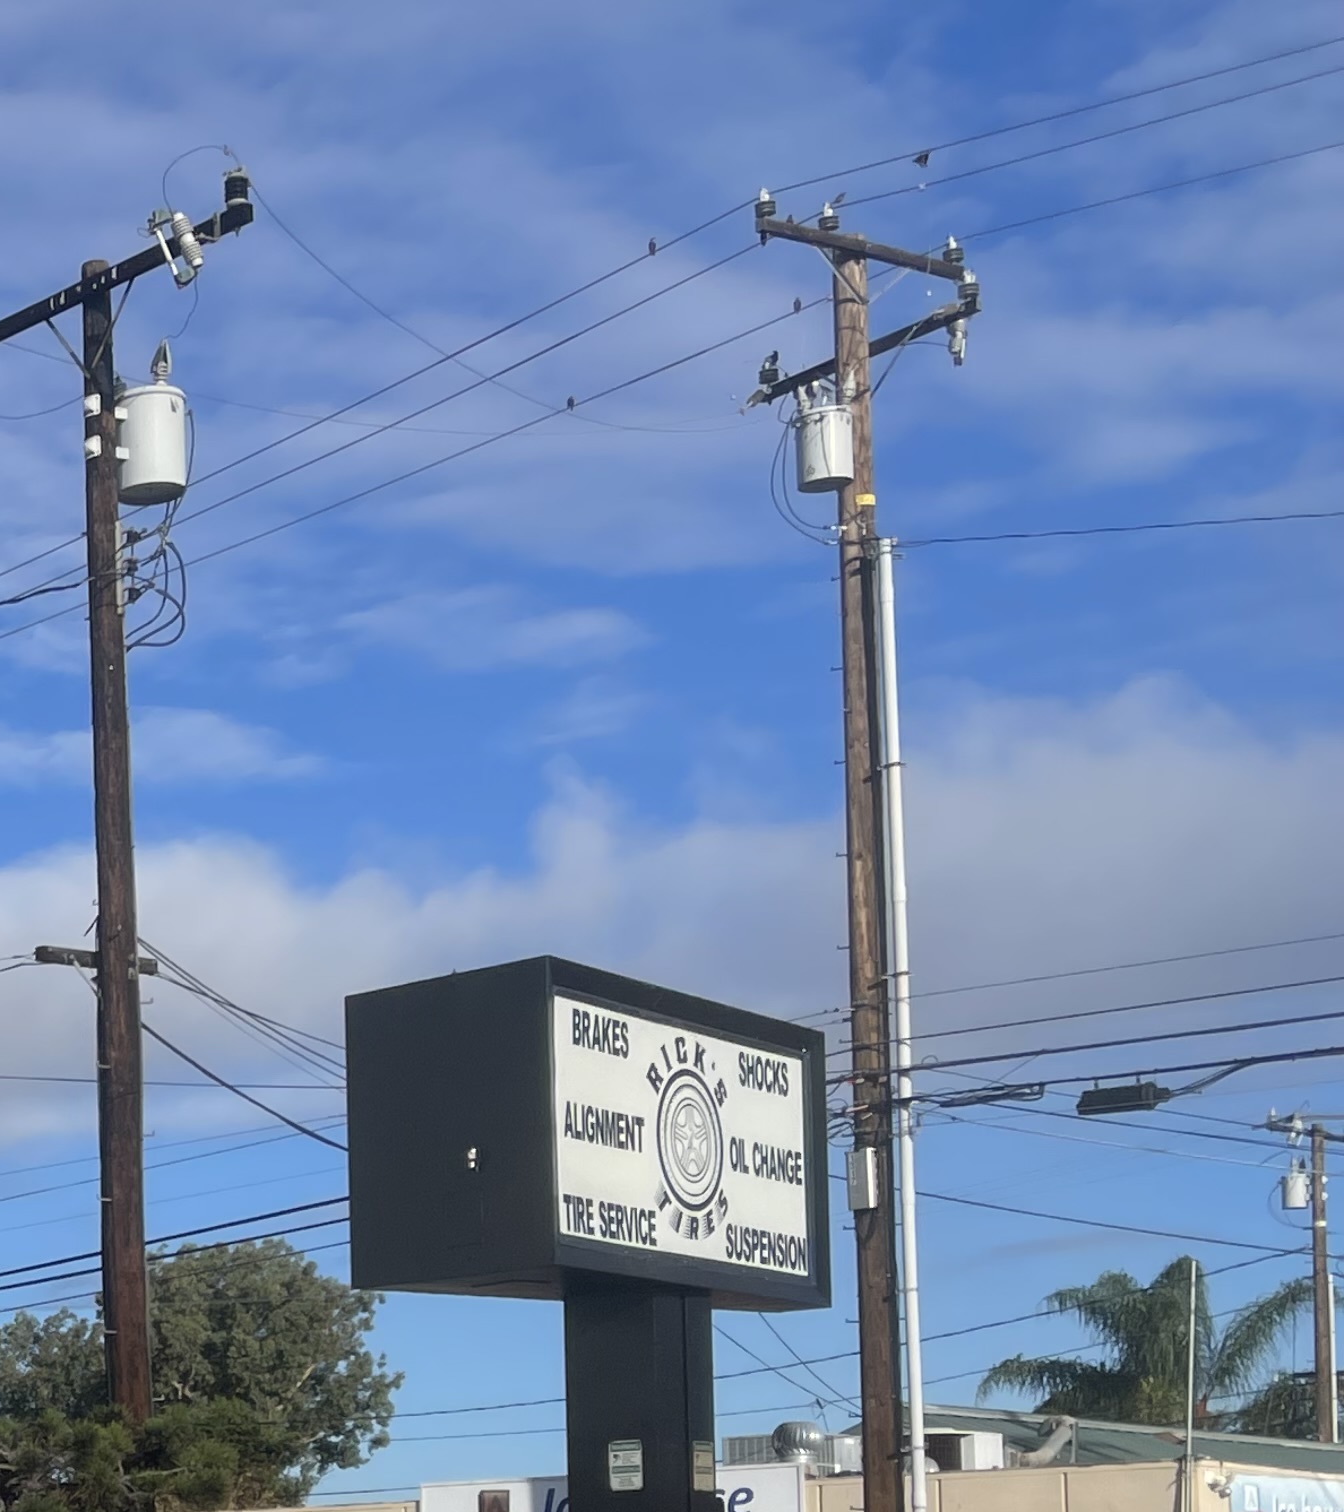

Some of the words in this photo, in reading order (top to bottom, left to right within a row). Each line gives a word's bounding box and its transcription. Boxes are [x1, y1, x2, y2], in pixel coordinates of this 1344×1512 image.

[572, 1008, 629, 1059] BRAKES
[739, 1051, 789, 1097] SHOCKS
[564, 1101, 645, 1153] ALIGNMENT
[730, 1136, 749, 1174] OIL
[753, 1142, 802, 1185] CHANGE
[563, 1194, 595, 1236] TIRE
[599, 1200, 657, 1246] SERVICE
[656, 1189, 728, 1241] TIRES
[726, 1224, 808, 1272] SUSPENSION
